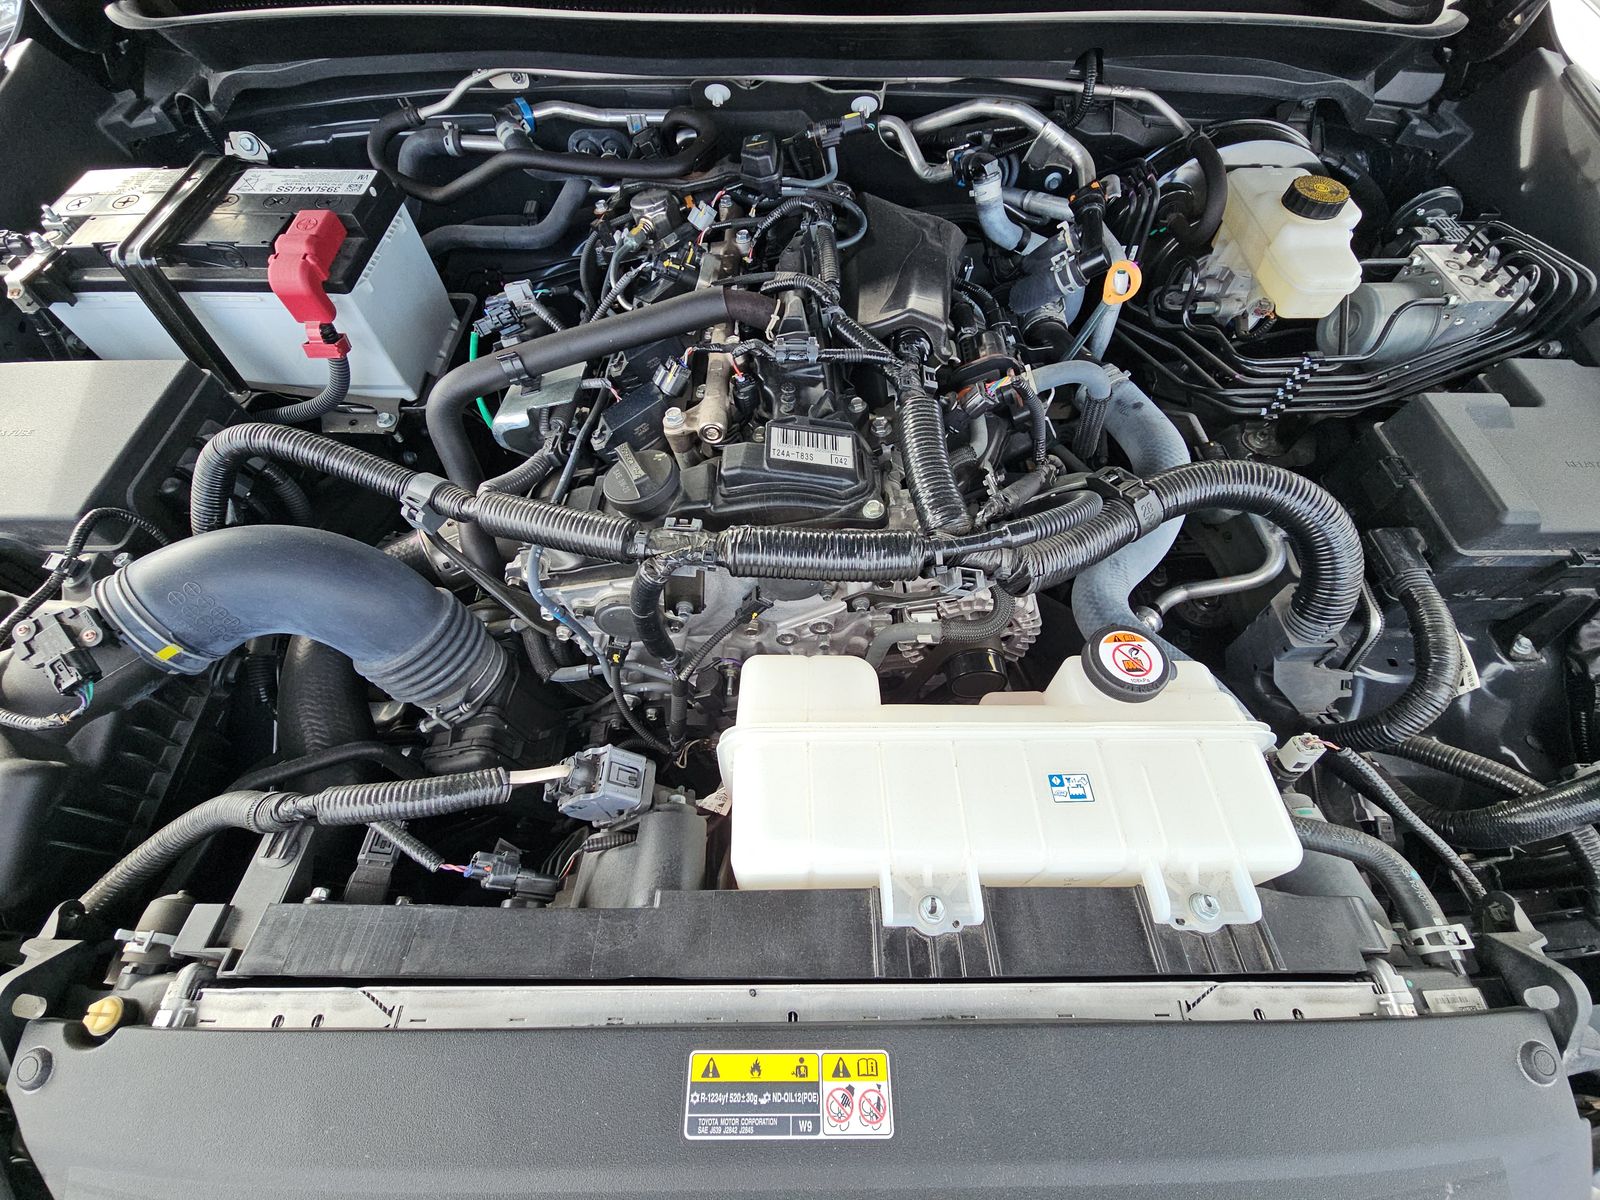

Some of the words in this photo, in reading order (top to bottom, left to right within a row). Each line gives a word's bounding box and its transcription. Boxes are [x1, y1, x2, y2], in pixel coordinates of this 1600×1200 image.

[275, 185, 341, 193] 395LN4-ISS
[772, 449, 814, 461] T24A-T83S
[834, 457, 848, 465] 042
[700, 1092, 728, 1105] R-1234yf
[729, 1092, 758, 1104] 520±30g
[772, 1092, 819, 1104] ND-OIL12(POE)
[698, 1118, 719, 1126] TOYOTA
[720, 1118, 740, 1126] MOTOR
[740, 1118, 777, 1126] CORPORATION
[798, 1120, 813, 1132] W9
[697, 1126, 708, 1134] SAE
